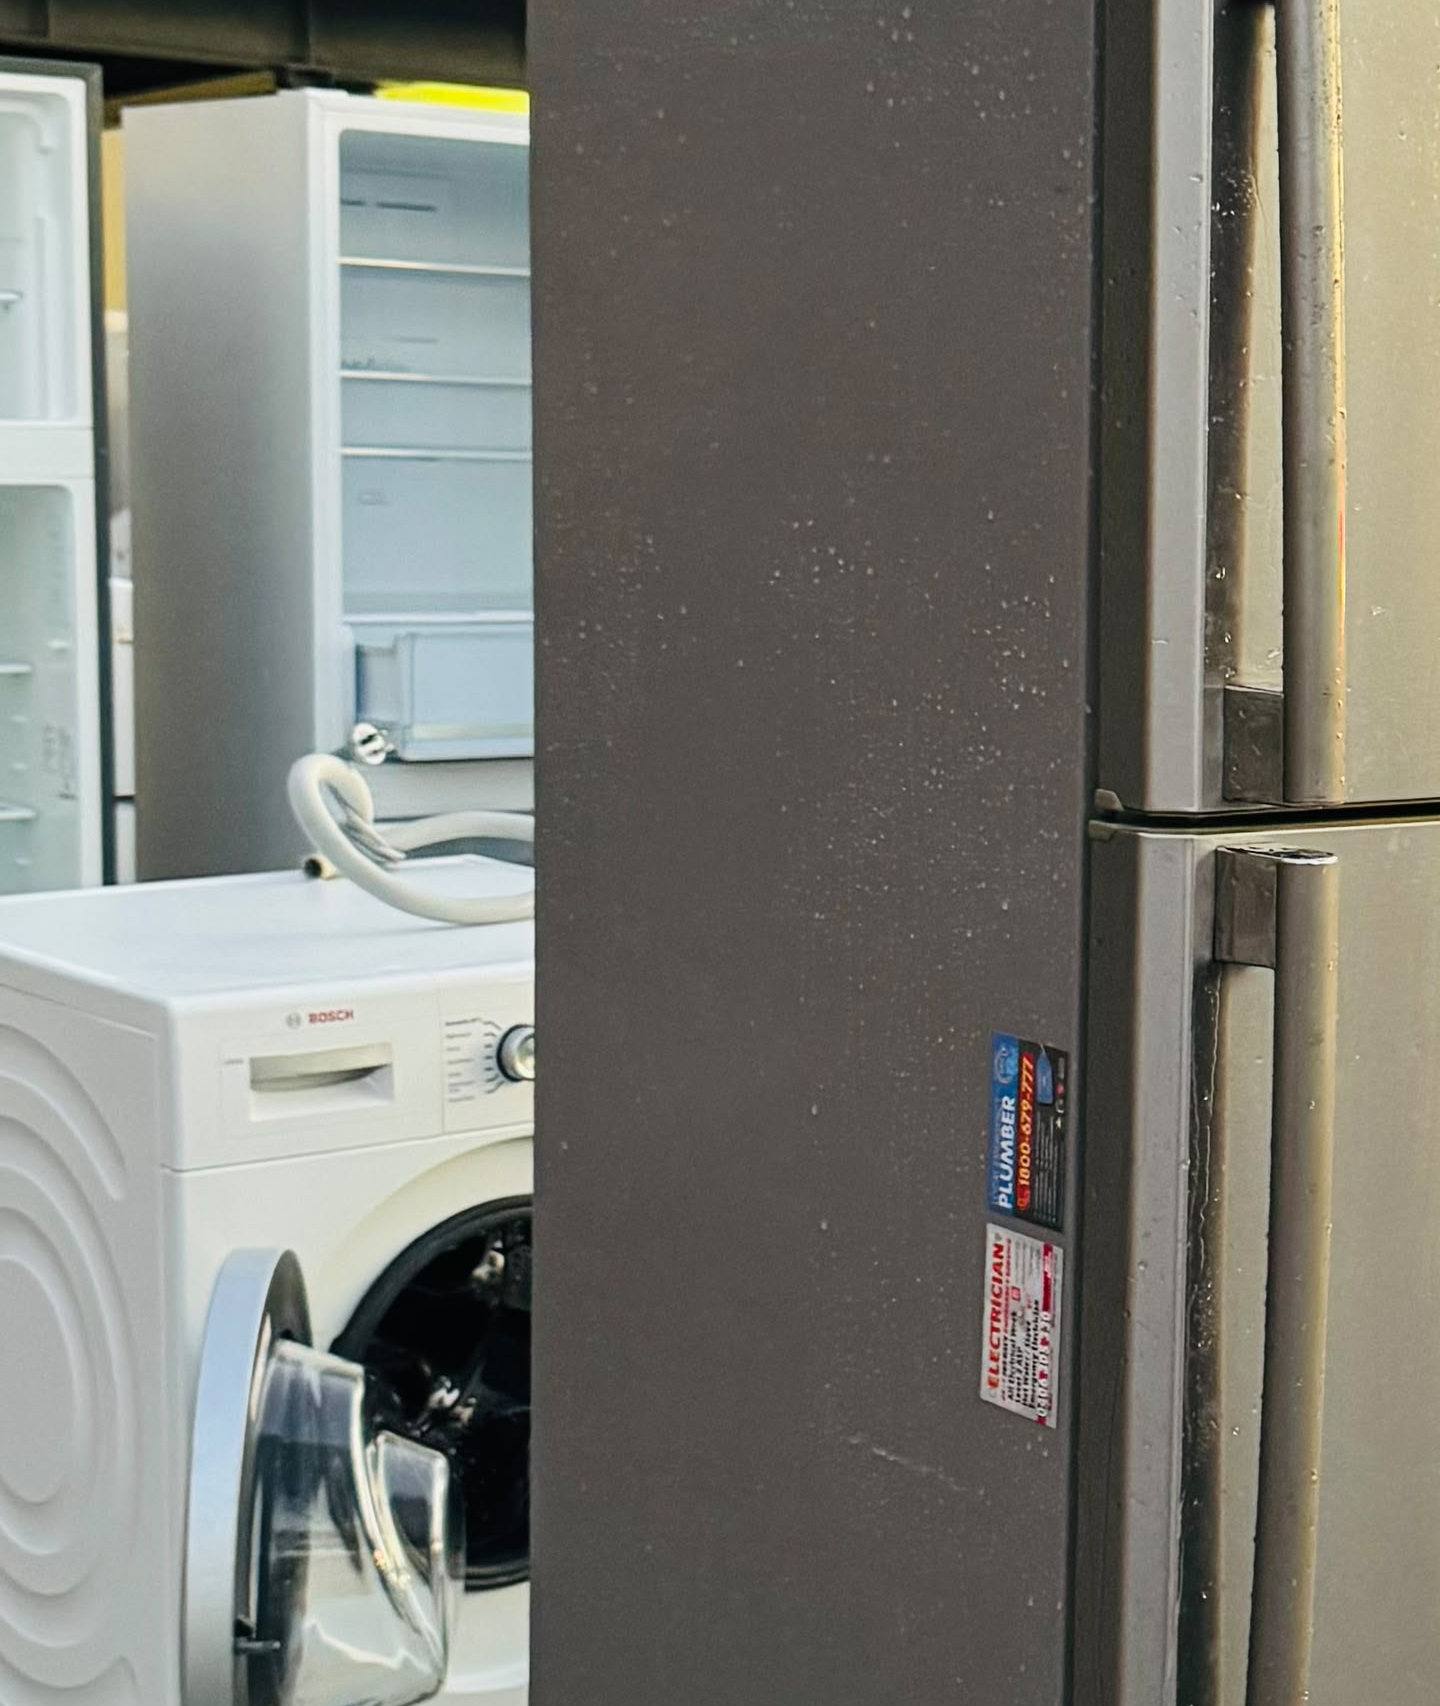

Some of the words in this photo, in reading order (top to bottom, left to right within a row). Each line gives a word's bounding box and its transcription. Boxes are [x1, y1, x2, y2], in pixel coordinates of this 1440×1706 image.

[308, 1009, 354, 1024] BOSCH
[998, 1095, 1016, 1209] PLUMBER
[988, 1242, 1004, 1389] ELECTRICIAN
